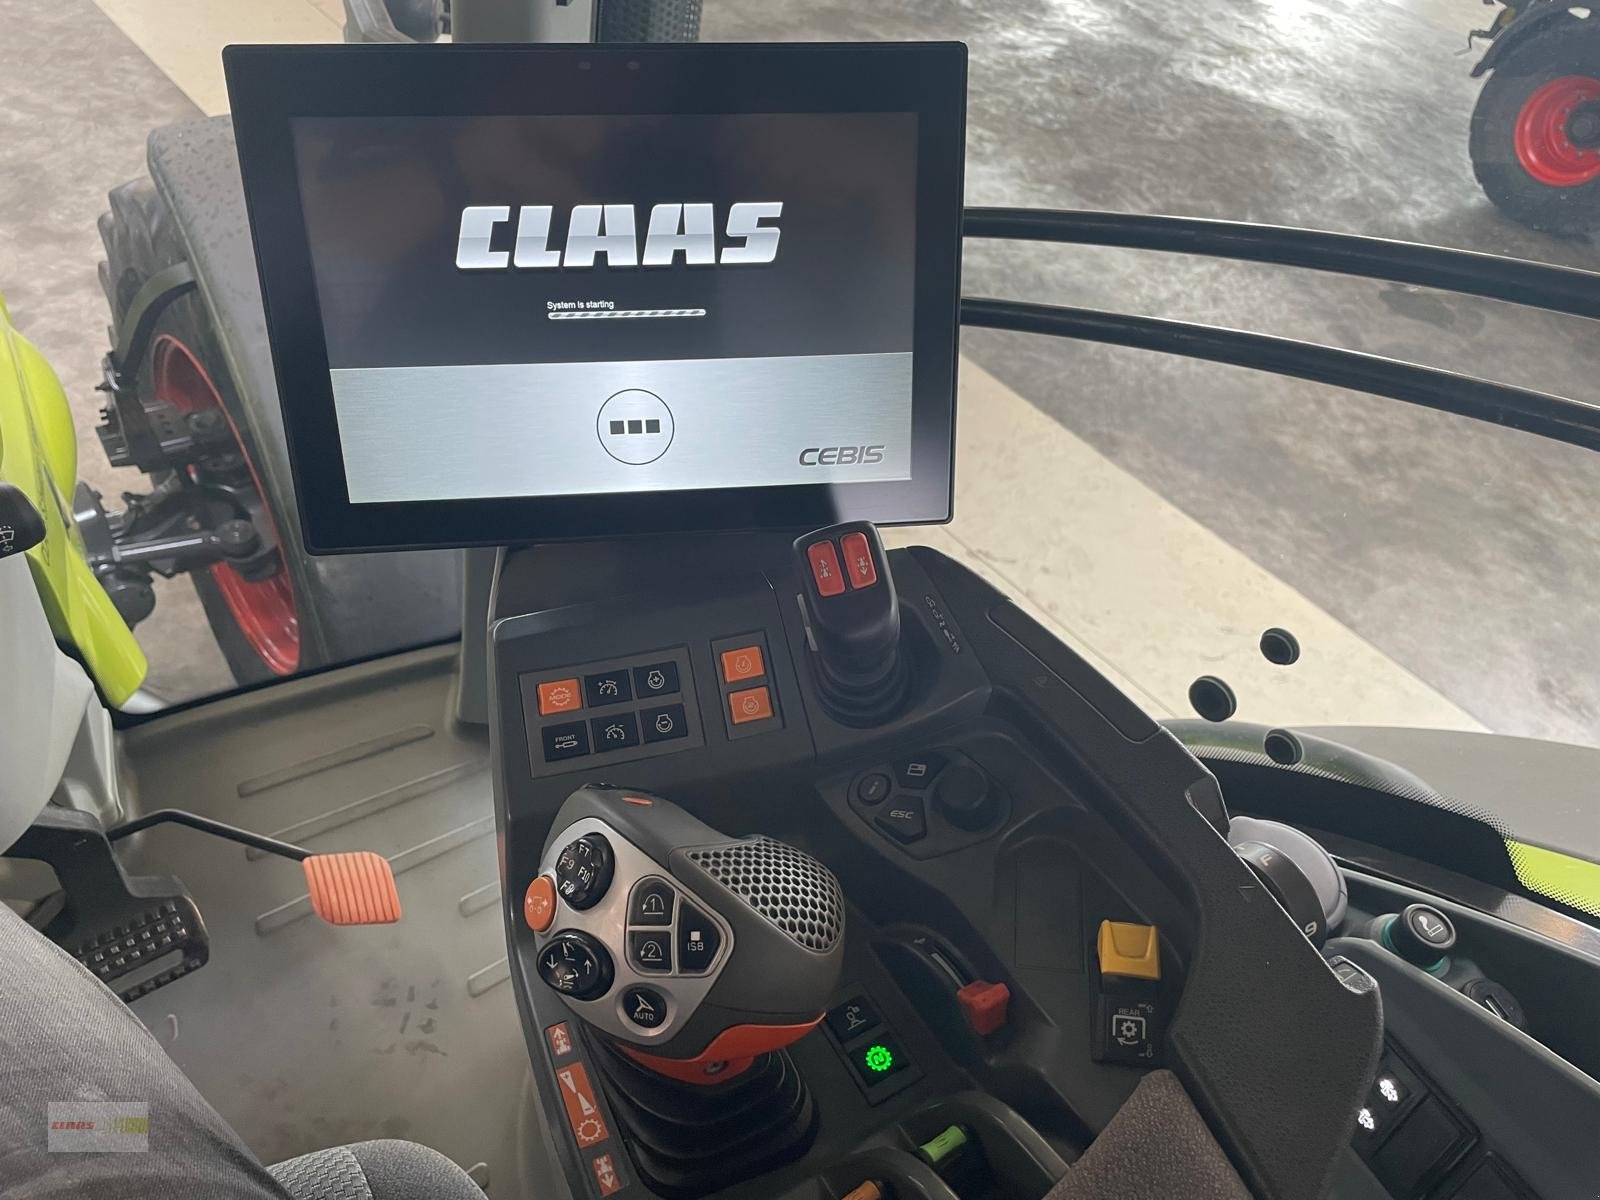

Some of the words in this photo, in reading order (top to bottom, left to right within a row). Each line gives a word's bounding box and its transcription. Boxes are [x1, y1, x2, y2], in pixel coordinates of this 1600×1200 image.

[455, 202, 784, 269] CLAAS
[546, 301, 576, 310] System
[586, 300, 615, 309] starting
[799, 445, 885, 466] CEBIS
[555, 734, 576, 743] FRONT
[890, 810, 914, 819] ESC
[578, 844, 590, 857] F7
[560, 855, 575, 870] F9
[578, 866, 590, 883] F10
[560, 880, 576, 894] F8
[650, 898, 656, 911] 1
[648, 944, 656, 958] 2
[688, 942, 704, 951] ISB
[633, 1012, 654, 1020] AUTO
[1118, 1008, 1140, 1016] REAR
